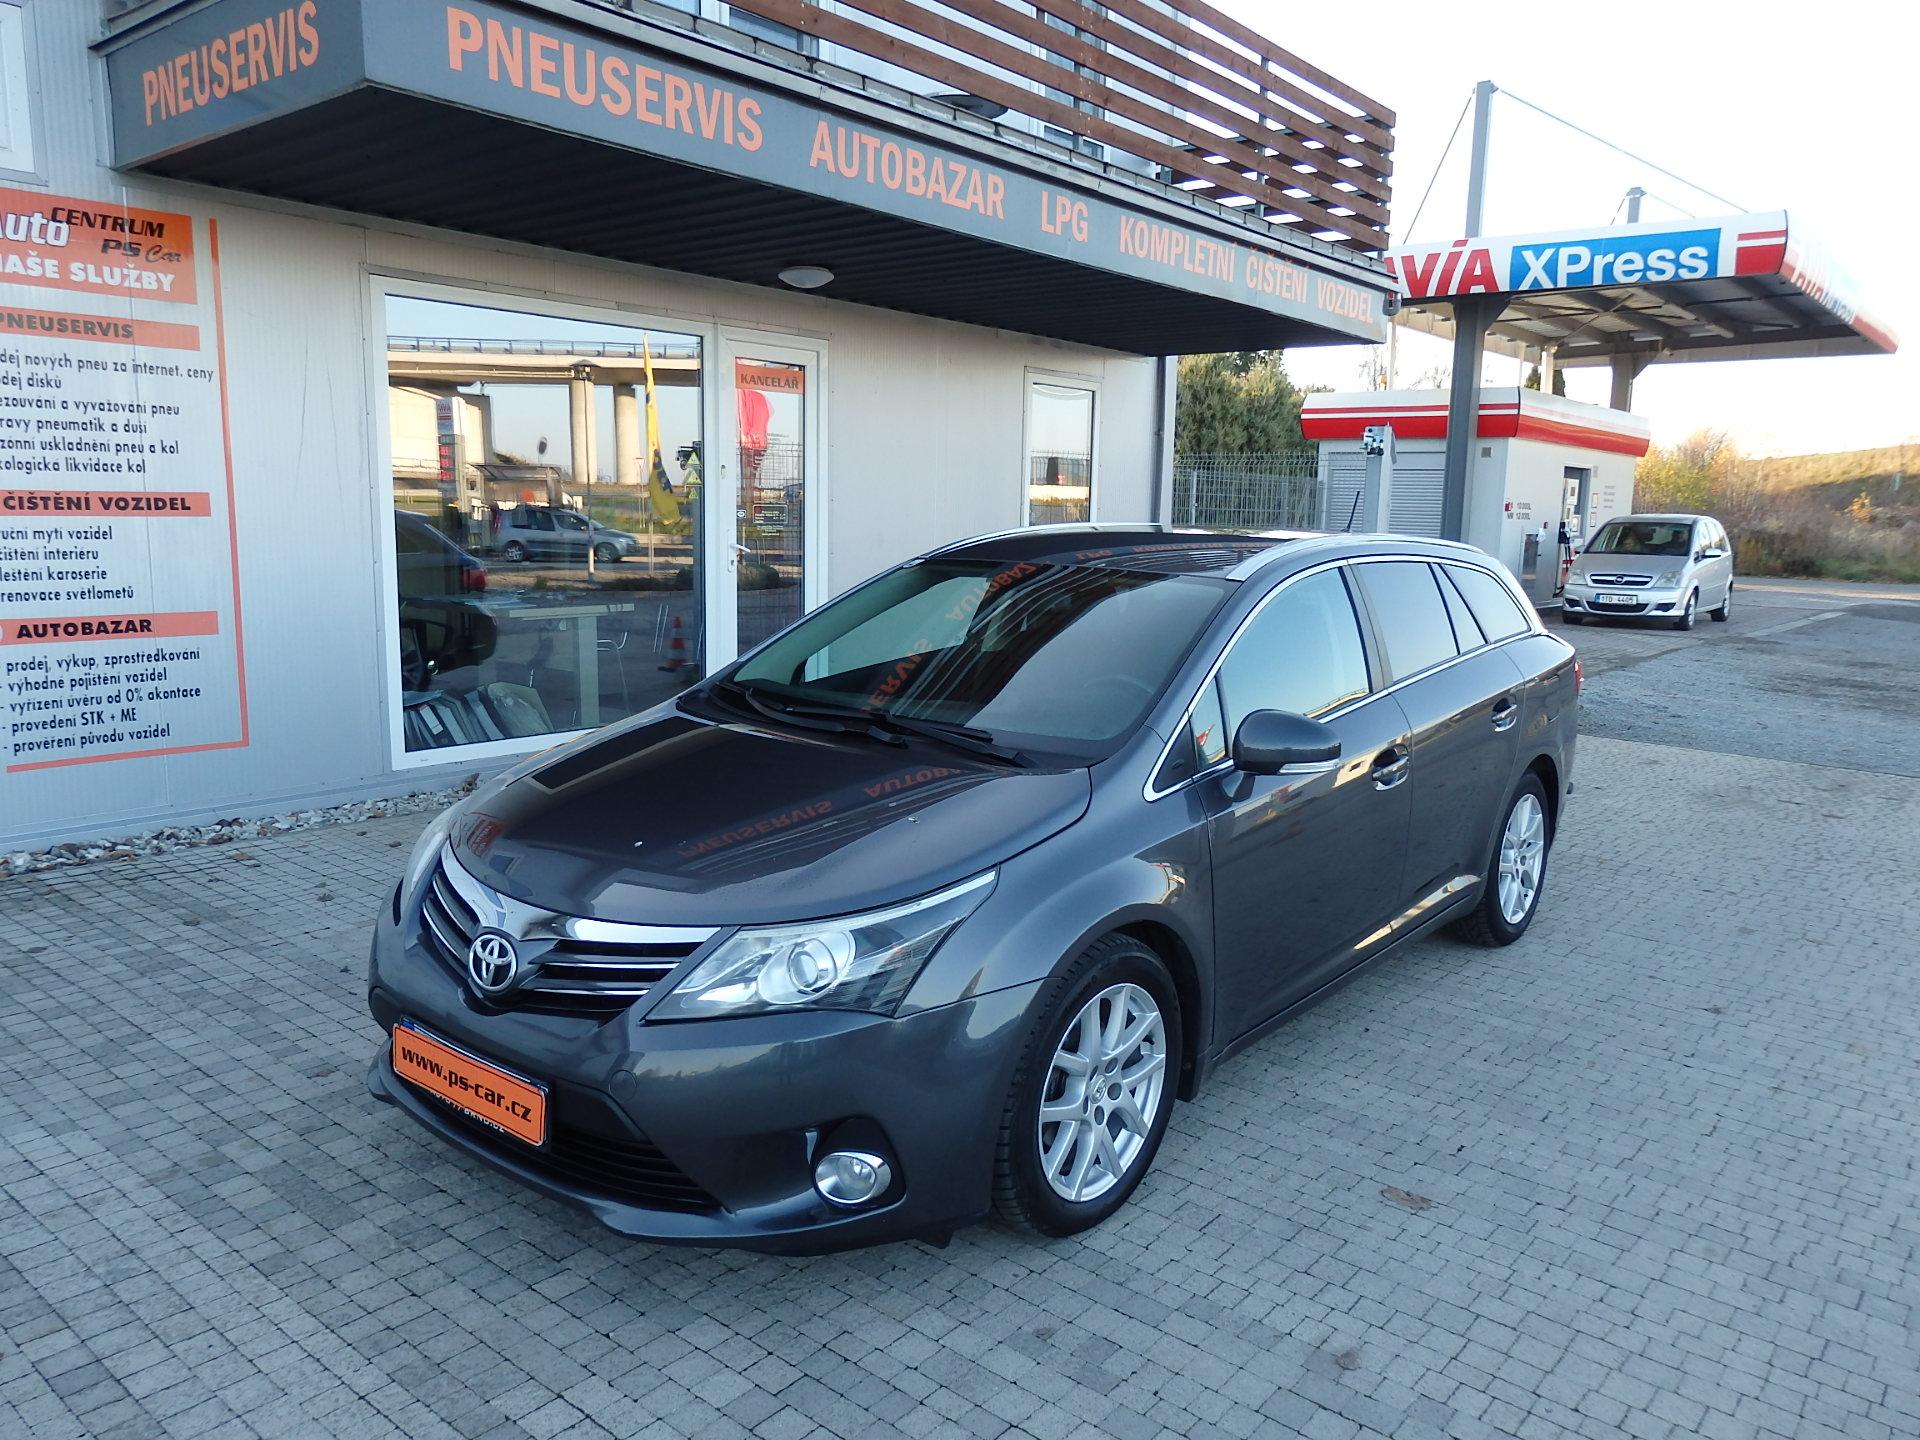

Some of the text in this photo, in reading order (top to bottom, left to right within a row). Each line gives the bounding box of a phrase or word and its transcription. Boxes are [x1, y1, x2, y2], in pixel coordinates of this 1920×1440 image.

[142, 1, 320, 126] PNEUSERVIS
[447, 6, 1374, 324] PNEUSERVIS AUTOBAZAR LPG KOMPLETNÍ ČIŠTĚNÍ VOZIDEL
[51, 207, 165, 238] CENTRUM
[101, 238, 142, 257] PS
[0, 249, 175, 292] AŠE SLUŽBY
[1519, 246, 1709, 291] XPress
[25, 353, 72, 371] nových
[77, 359, 108, 373] pneu
[113, 362, 127, 372] za
[187, 368, 214, 383] ceny
[61, 400, 69, 409] a
[74, 399, 147, 414] vyvažování
[152, 404, 180, 418] pneu
[37, 417, 105, 433] pneumatik
[111, 423, 118, 432] a
[40, 436, 111, 452] uskladnění
[115, 442, 144, 456] pneu
[149, 444, 156, 453] a
[160, 440, 179, 454] kol
[65, 457, 123, 473] likvidace
[127, 458, 146, 473] kol
[3, 491, 191, 511] ČIŠTĚNÍ VOZIDEL
[68, 525, 112, 540] vozidel
[44, 546, 99, 560] interiéru
[47, 566, 107, 580] karoserie
[0, 585, 134, 602] renovace světlometů
[17, 619, 152, 638] AUTOBAZAR
[104, 647, 200, 669] zprostředkování
[8, 667, 168, 695] výhodné pojištění vozidel
[107, 690, 122, 704] od
[126, 688, 143, 702] 0%
[147, 686, 201, 701] akontace
[12, 714, 76, 736] provedení
[81, 710, 105, 726] STK
[120, 707, 137, 722] ME
[13, 723, 171, 756] prověření původu vozidel
[401, 1046, 532, 1123] www.ps-car.cz
